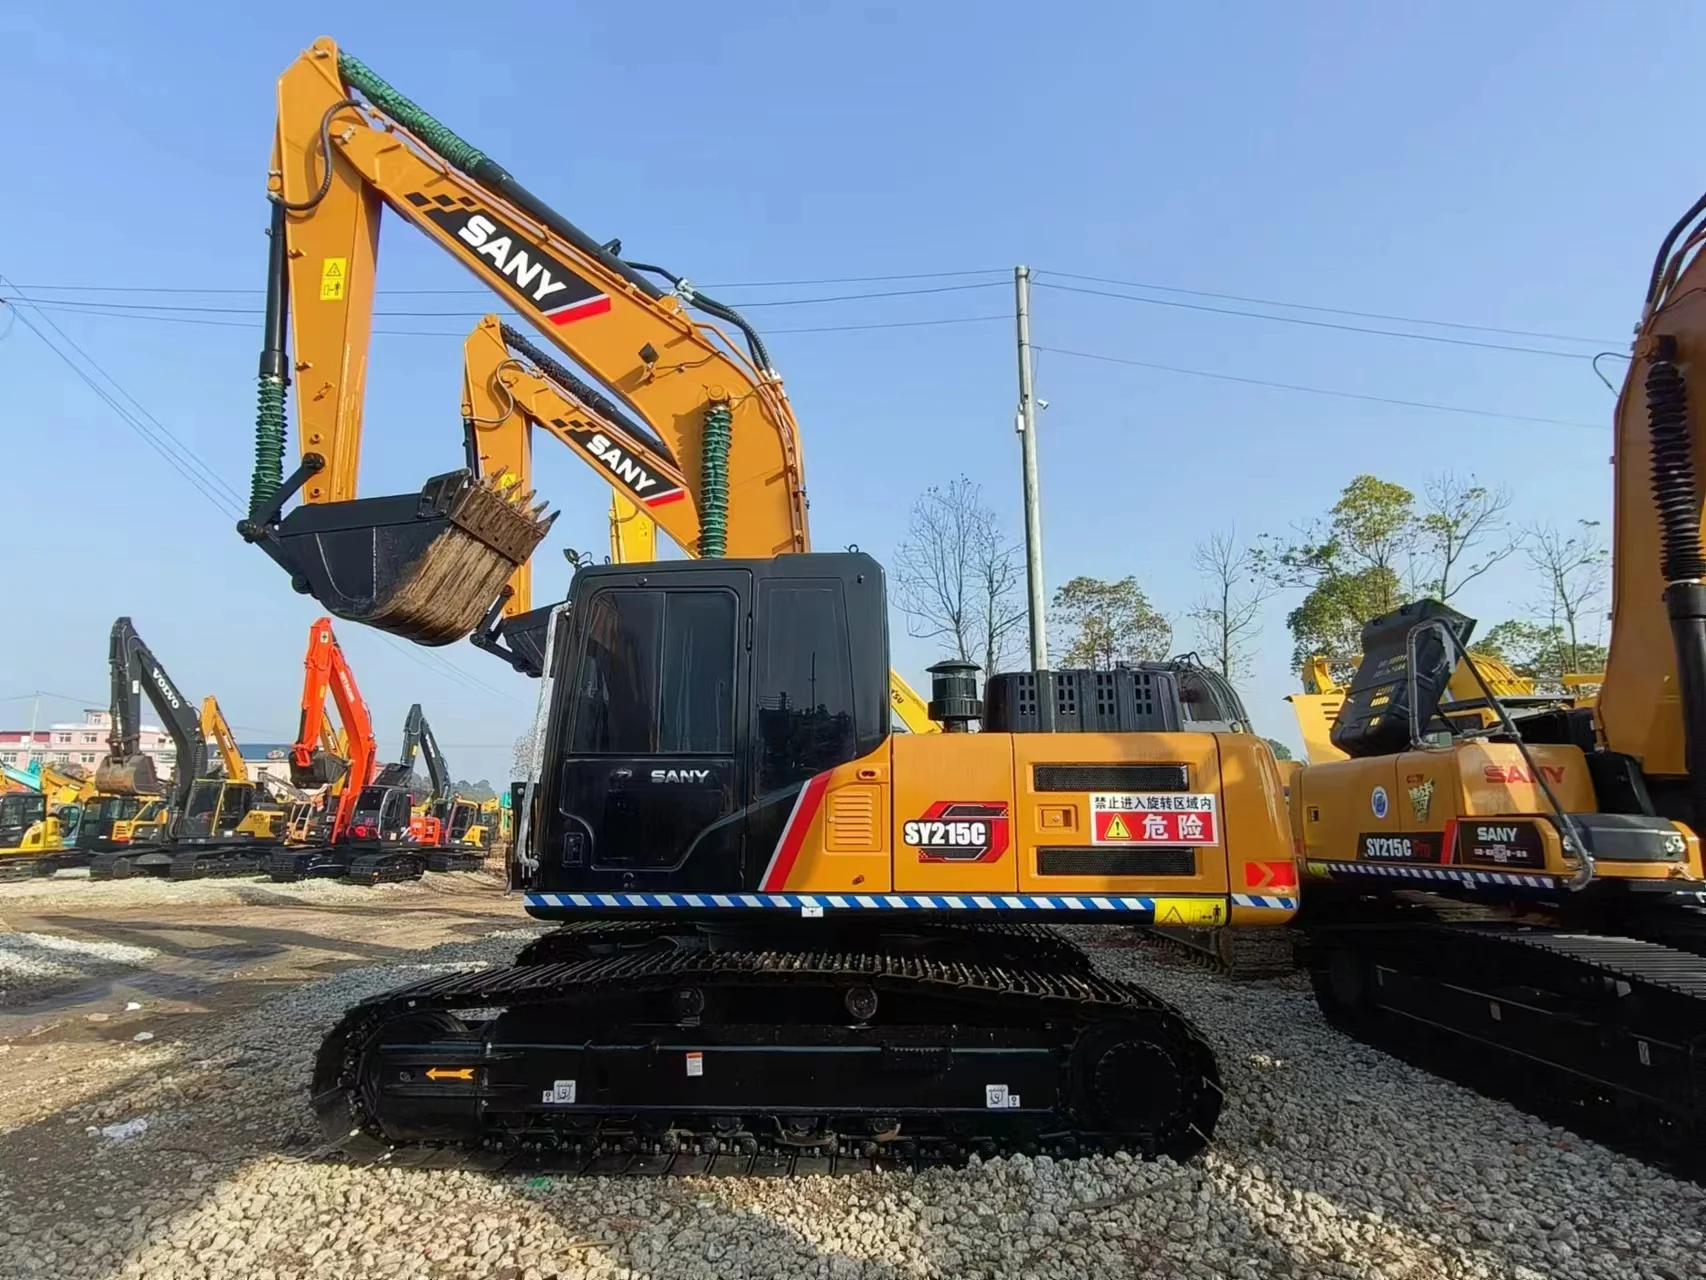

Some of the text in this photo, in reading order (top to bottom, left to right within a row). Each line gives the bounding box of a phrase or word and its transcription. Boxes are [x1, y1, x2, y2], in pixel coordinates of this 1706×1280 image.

[457, 214, 567, 302] SANY
[585, 433, 657, 492] SANY
[152, 666, 179, 709] VOLVO
[651, 769, 710, 783] SANY
[1095, 796, 1211, 810] 禁止进入旋转区域内
[904, 821, 986, 846] SY215C
[1142, 813, 1204, 839] 危险
[1476, 827, 1518, 842] SANY
[1366, 838, 1412, 857] SY215C
